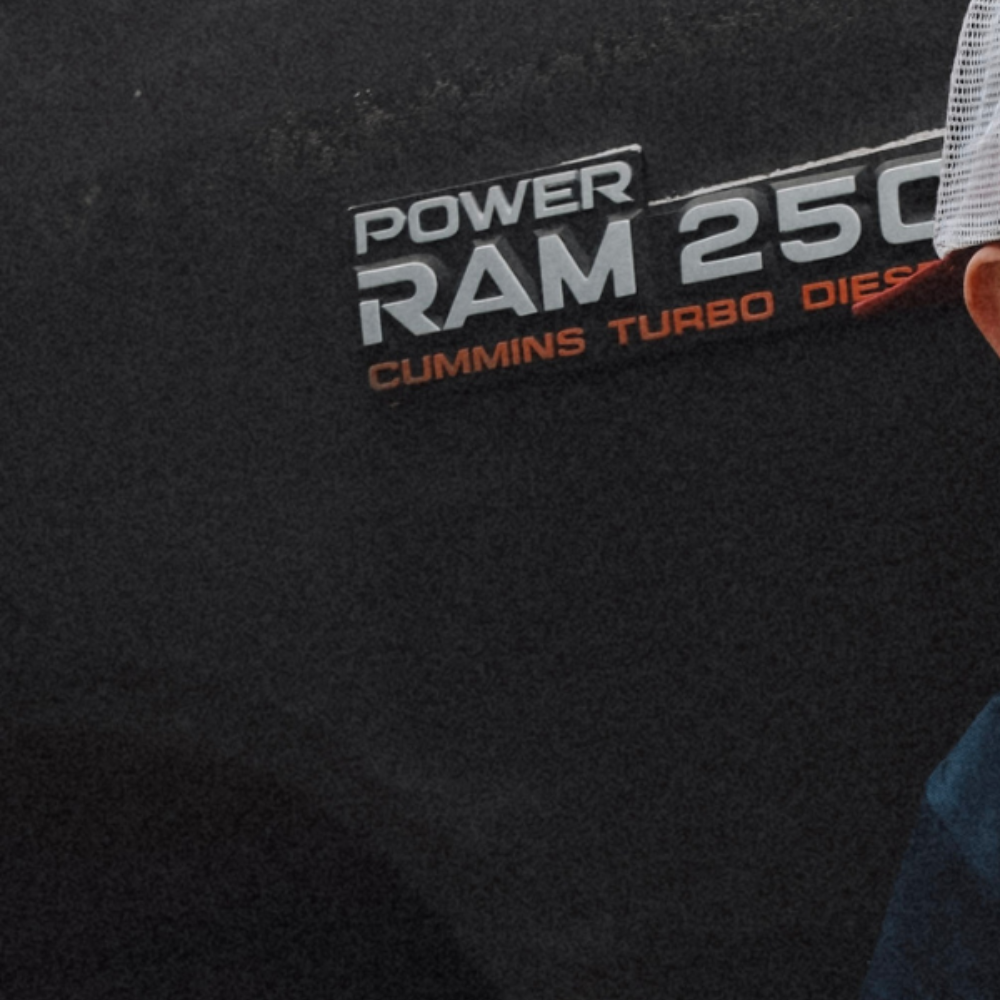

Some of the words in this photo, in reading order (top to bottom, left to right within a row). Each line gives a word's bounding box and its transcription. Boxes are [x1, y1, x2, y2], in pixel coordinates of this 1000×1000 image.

[354, 160, 633, 255] POWER
[356, 217, 637, 345] RAM
[369, 327, 586, 391] CUMMINS
[608, 290, 775, 345] TURBO
[802, 258, 943, 311] DIES
